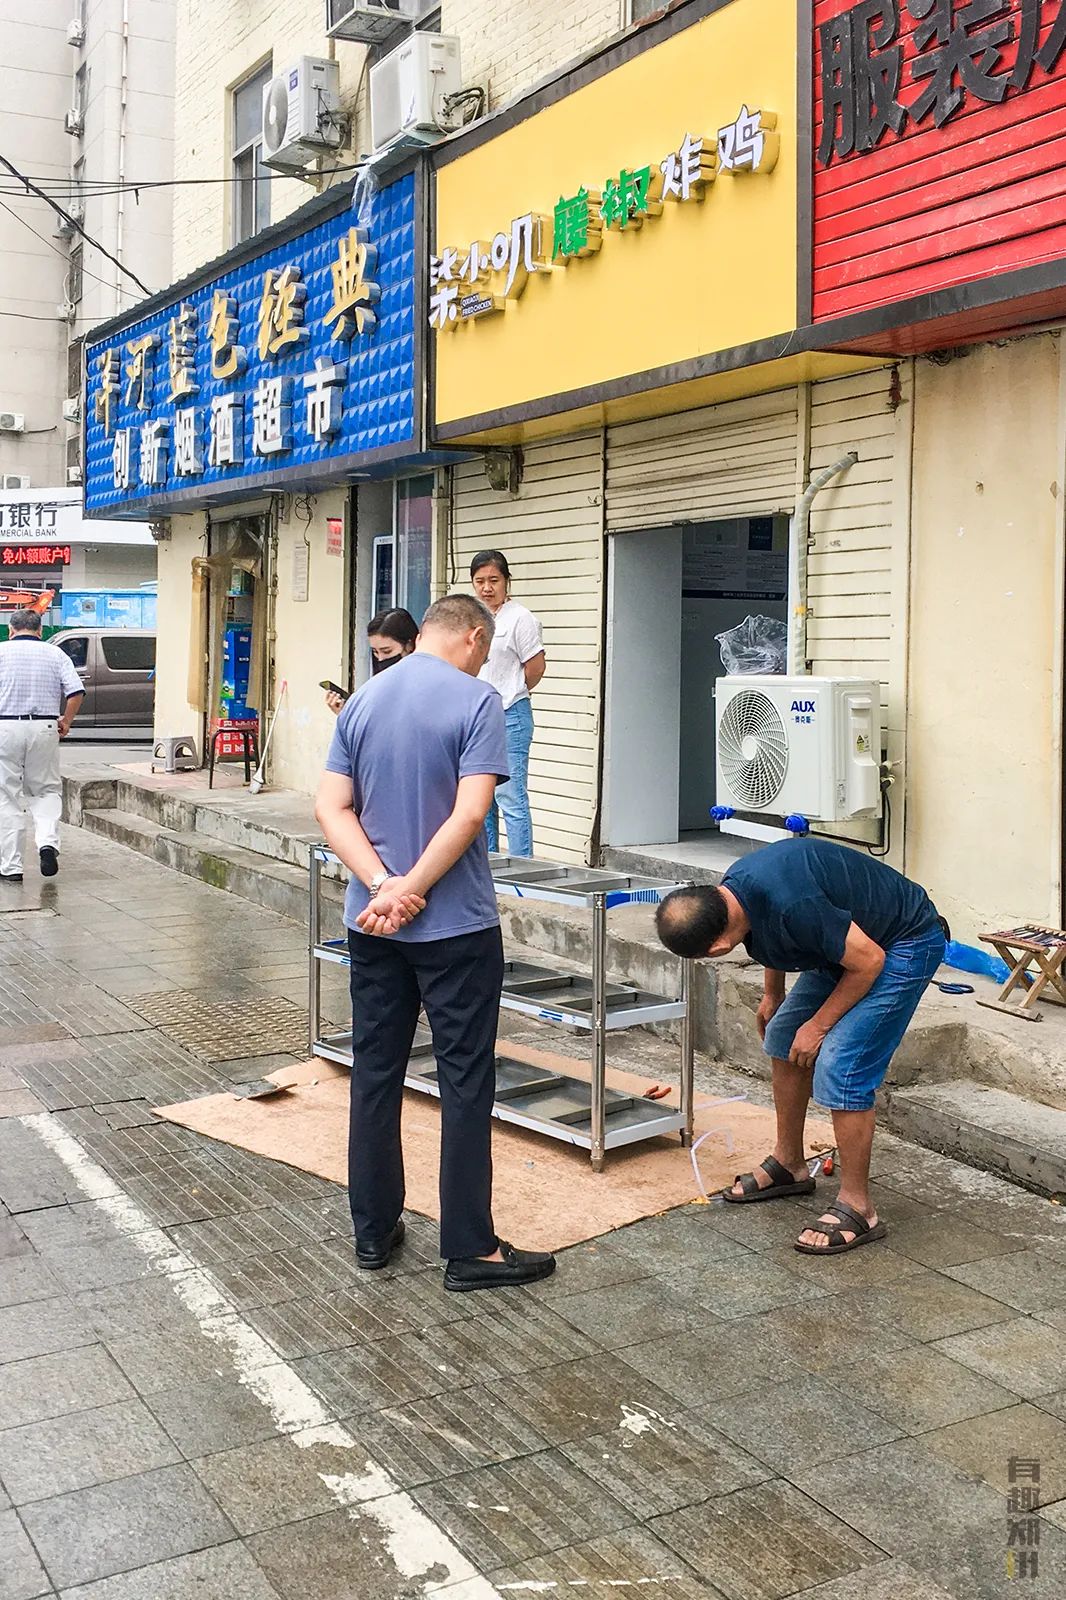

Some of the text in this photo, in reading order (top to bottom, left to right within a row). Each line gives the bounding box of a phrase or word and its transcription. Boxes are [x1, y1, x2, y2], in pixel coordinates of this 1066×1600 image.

[112, 356, 346, 489] 创新烟酒超市
[0, 502, 57, 528] 银行
[35, 528, 57, 537] BANK
[790, 700, 816, 713] AUX
